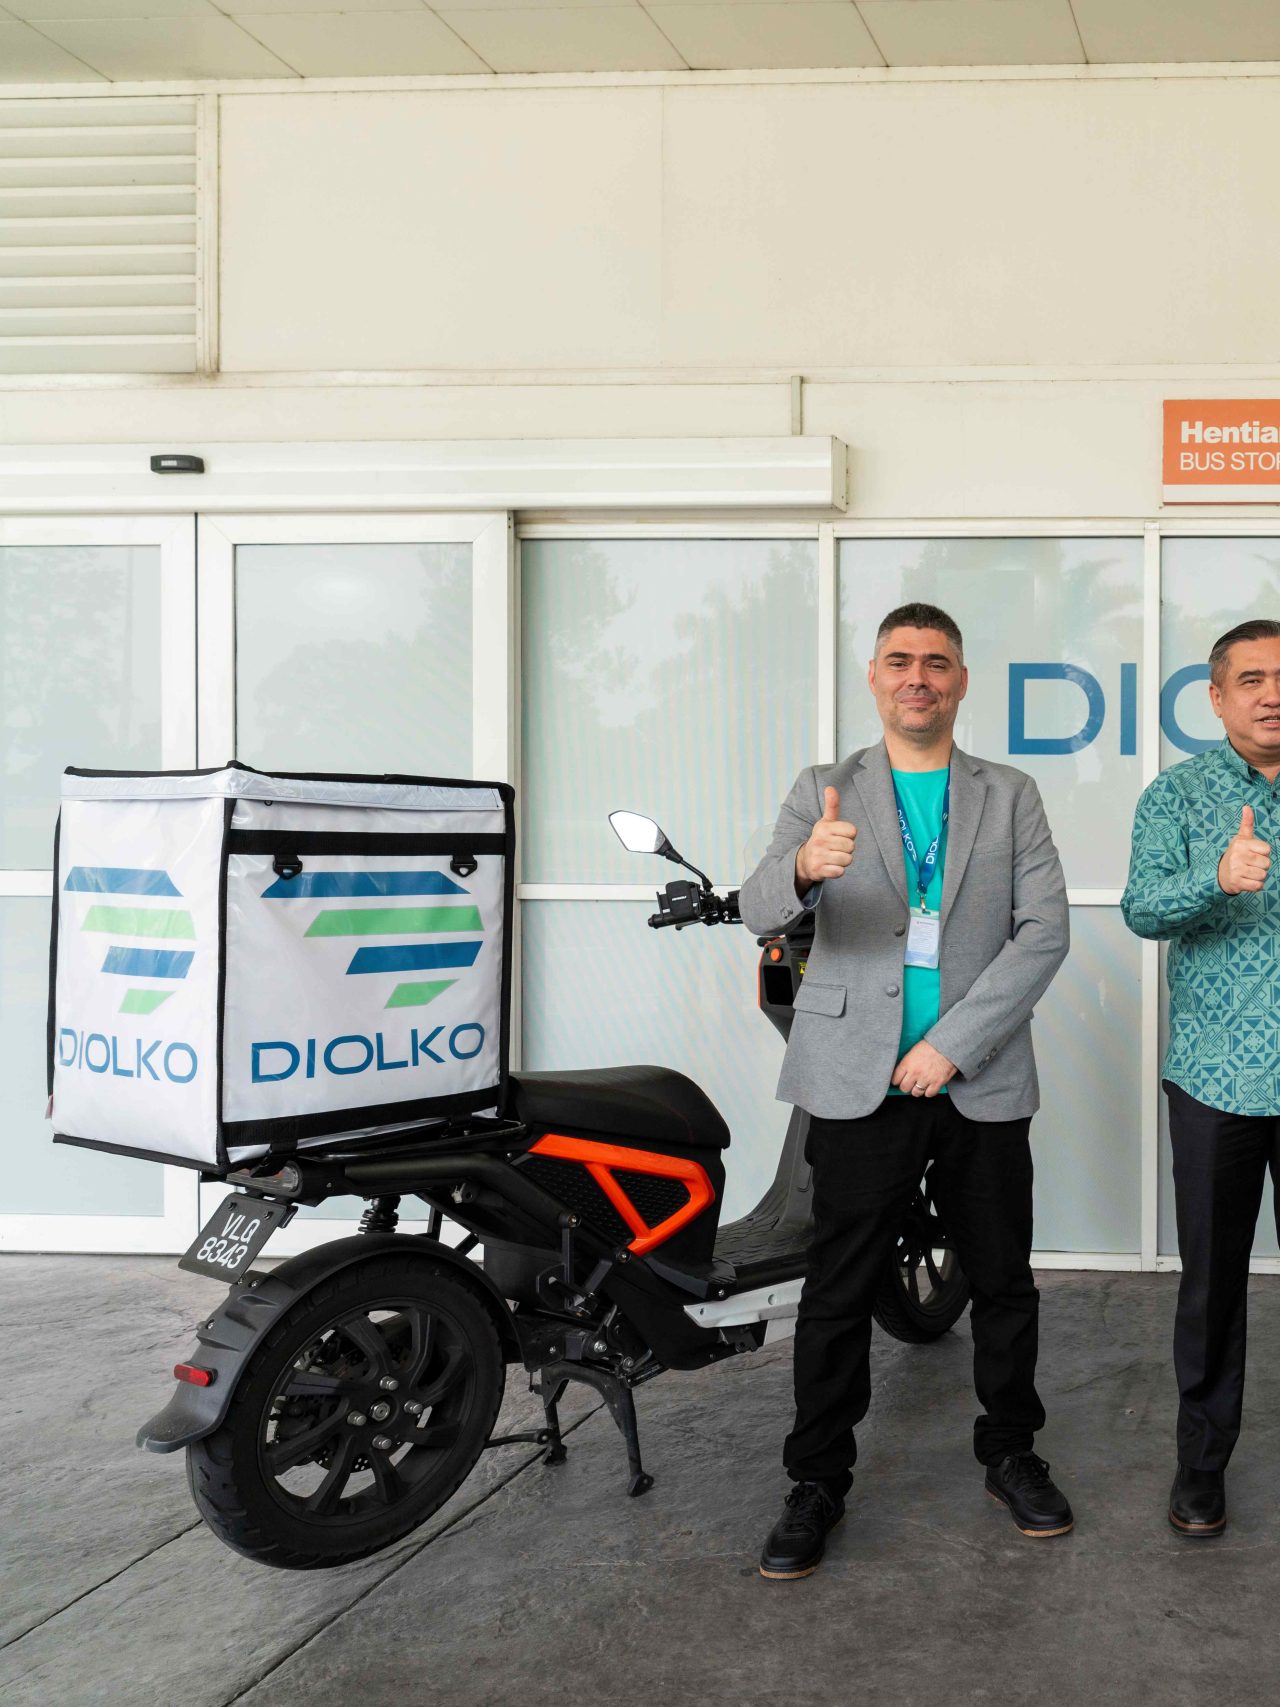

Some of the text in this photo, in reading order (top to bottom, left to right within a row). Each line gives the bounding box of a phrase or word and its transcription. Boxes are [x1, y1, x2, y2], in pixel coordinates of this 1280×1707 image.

[1180, 452, 1225, 471] BUS
[58, 1027, 199, 1084] DIOLKO
[252, 1022, 485, 1084] DIOLKO
[221, 1212, 261, 1243] VLQ
[196, 1236, 249, 1269] 8343
